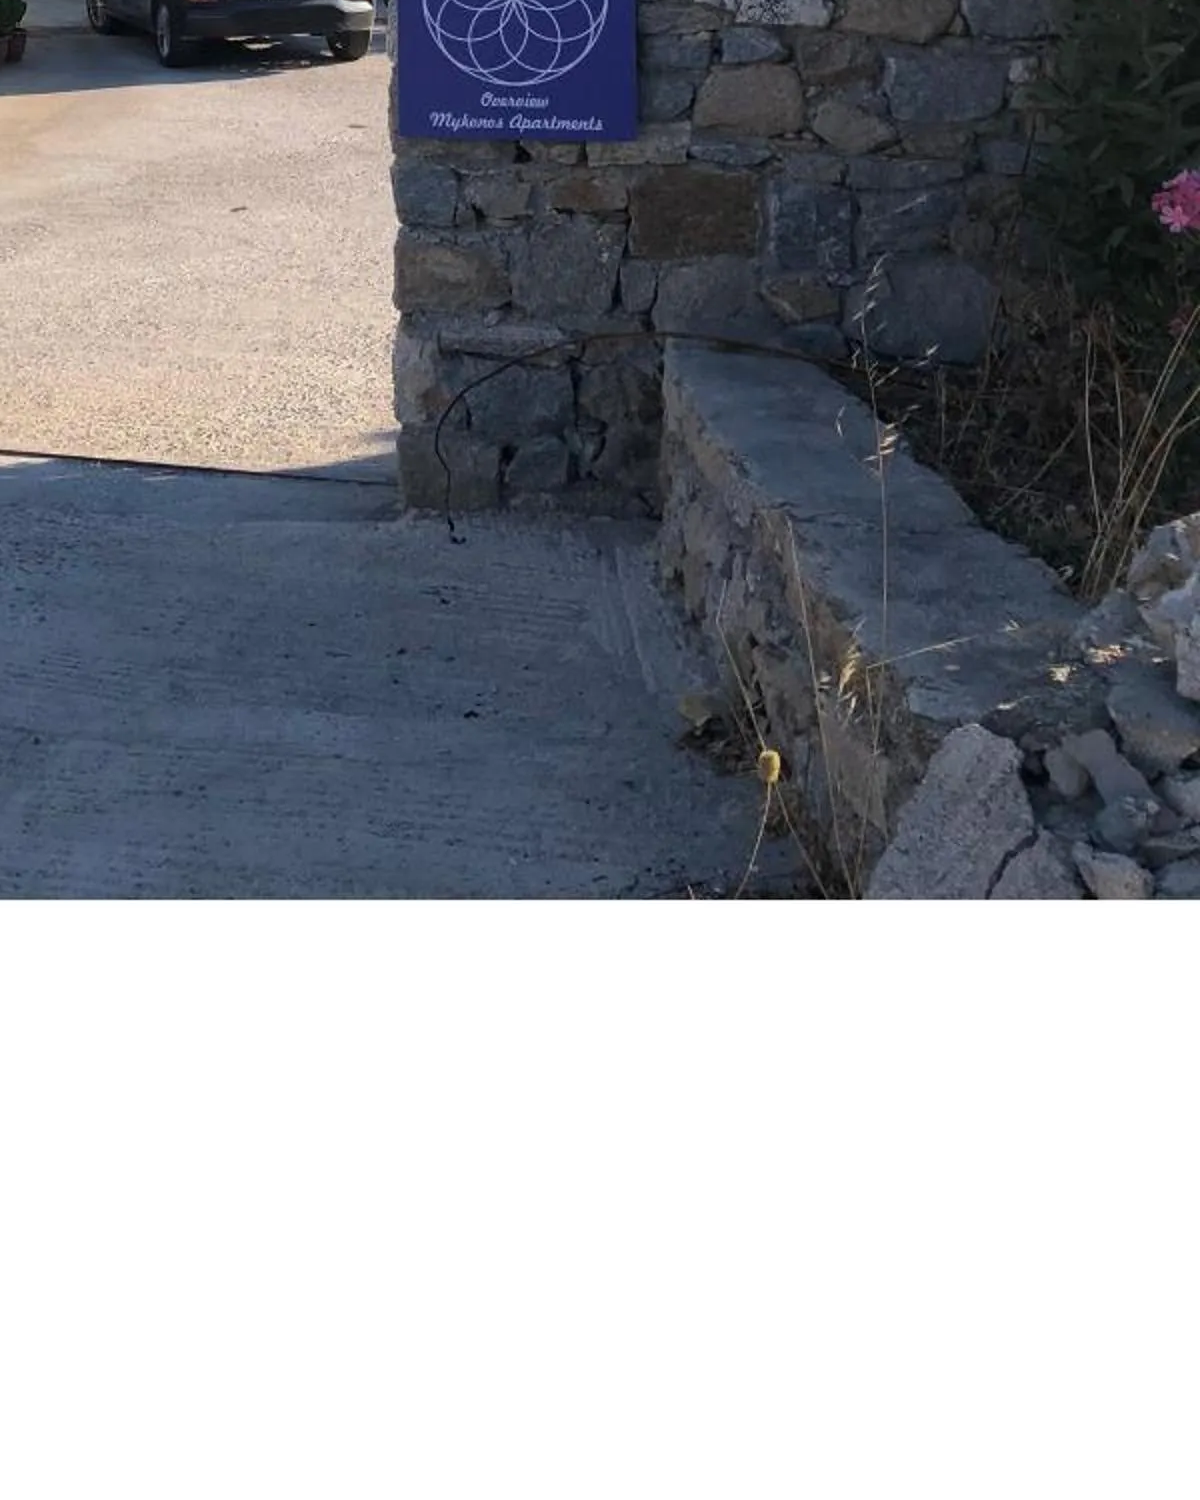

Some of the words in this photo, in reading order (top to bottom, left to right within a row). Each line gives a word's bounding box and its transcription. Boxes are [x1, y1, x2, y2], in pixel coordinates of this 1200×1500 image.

[479, 91, 550, 107] Overview
[429, 111, 504, 132] Mykonos
[508, 113, 604, 133] Apartments
